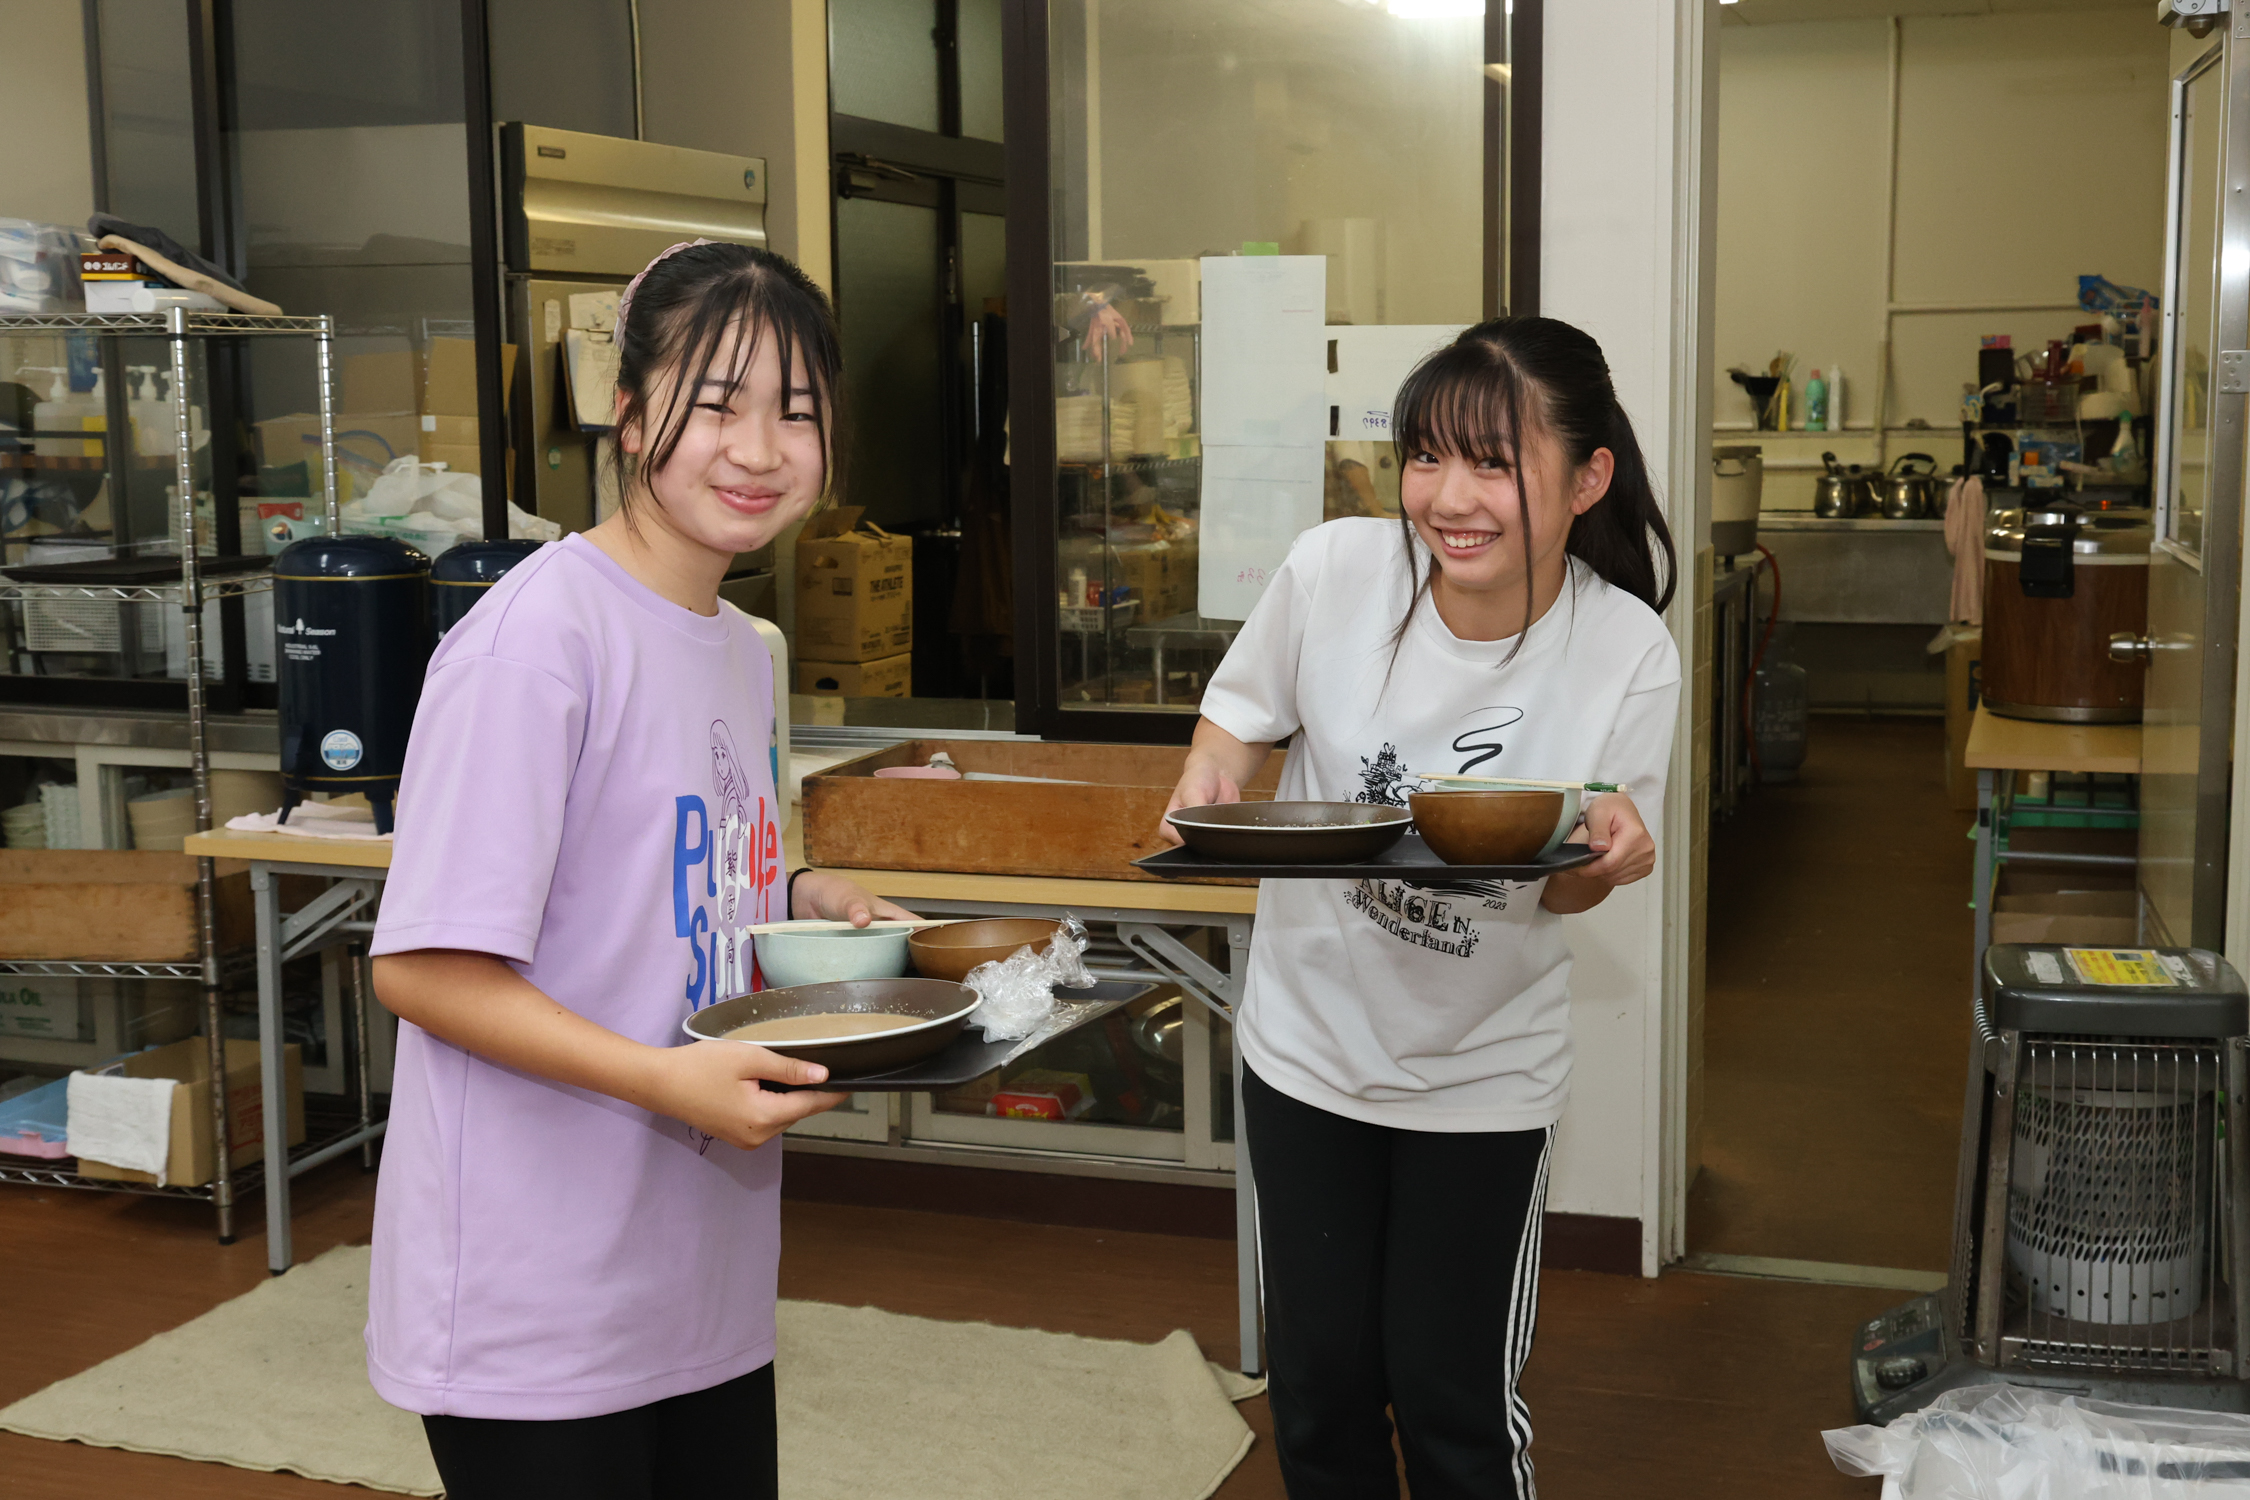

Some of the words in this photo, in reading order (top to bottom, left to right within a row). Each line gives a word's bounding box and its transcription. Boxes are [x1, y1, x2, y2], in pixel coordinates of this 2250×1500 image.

[305, 627, 336, 636] Season
[674, 795, 777, 937] Purple
[1350, 886, 1473, 958] Wonderland
[1358, 877, 1451, 932] ALICE
[1482, 899, 1508, 911] 2023
